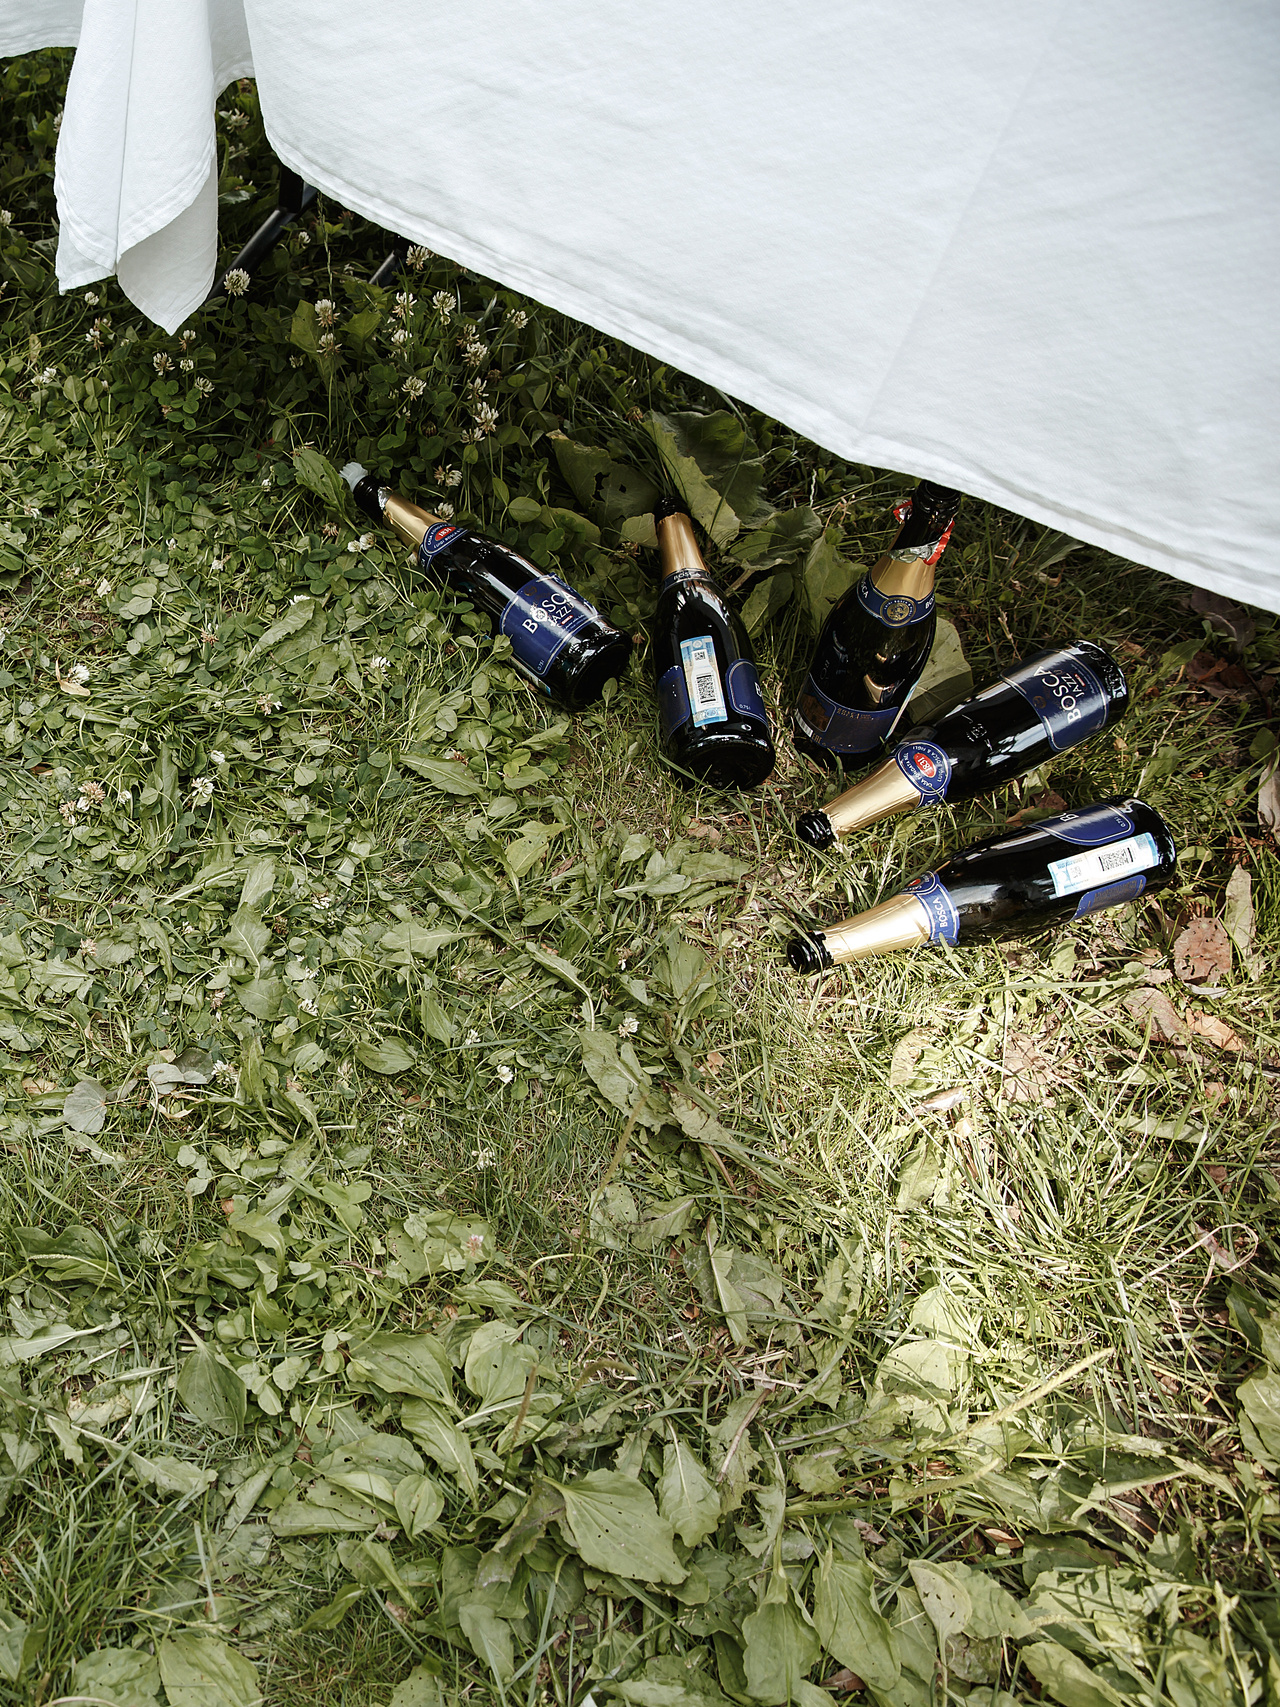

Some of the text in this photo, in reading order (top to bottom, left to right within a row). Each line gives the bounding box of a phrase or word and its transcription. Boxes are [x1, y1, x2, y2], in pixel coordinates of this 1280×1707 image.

[522, 591, 577, 635] BOSCA
[1032, 666, 1082, 724] BOSCA
[1061, 673, 1085, 698] JAZZ
[917, 757, 933, 772] 1831
[932, 896, 949, 928] BOSCA
